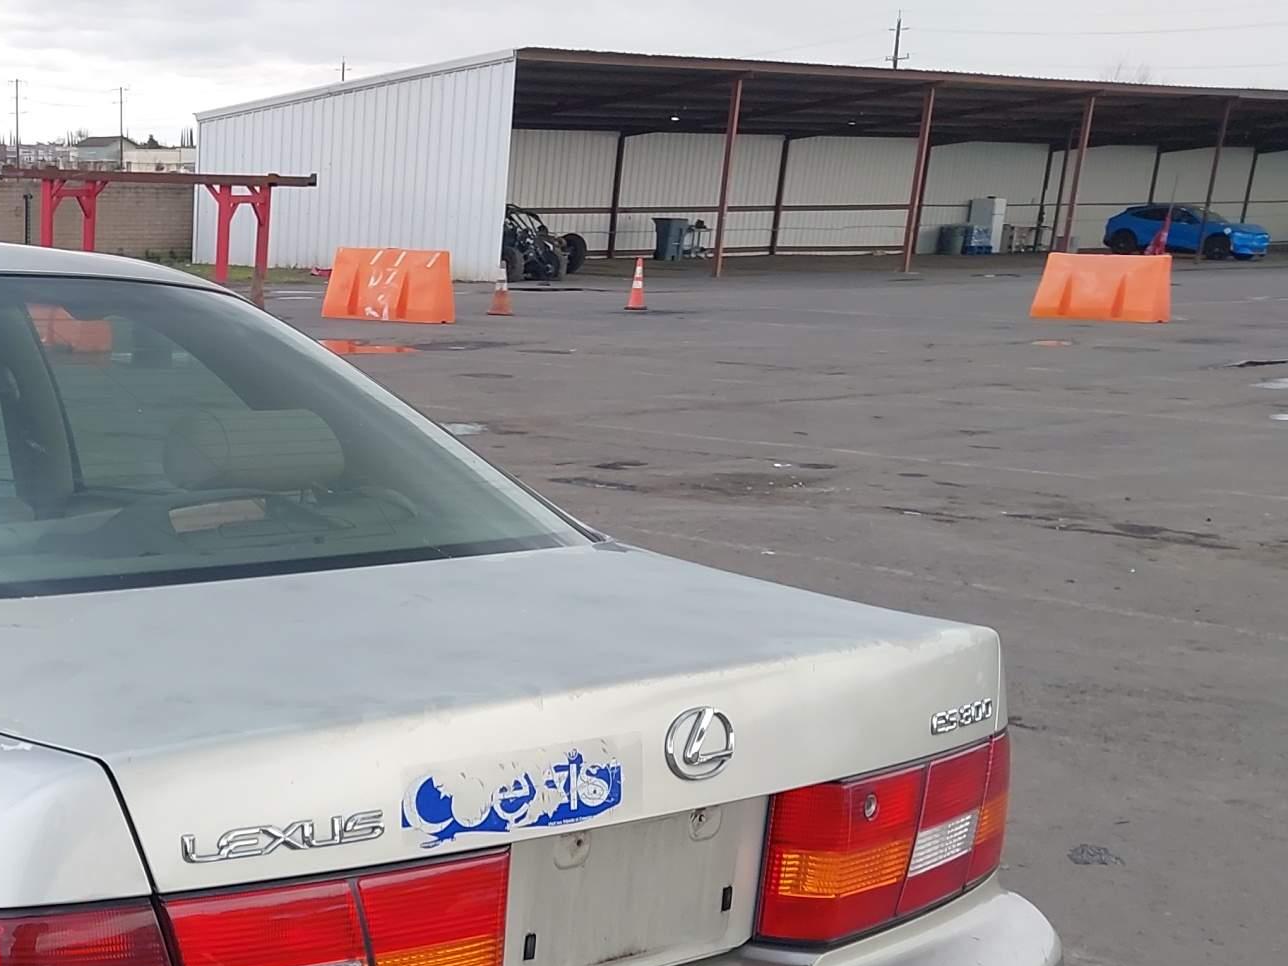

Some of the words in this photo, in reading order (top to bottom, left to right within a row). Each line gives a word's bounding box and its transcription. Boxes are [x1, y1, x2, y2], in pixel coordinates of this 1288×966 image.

[931, 708, 958, 735] ES
[958, 697, 993, 727] 300
[181, 809, 385, 864] LEXUS
